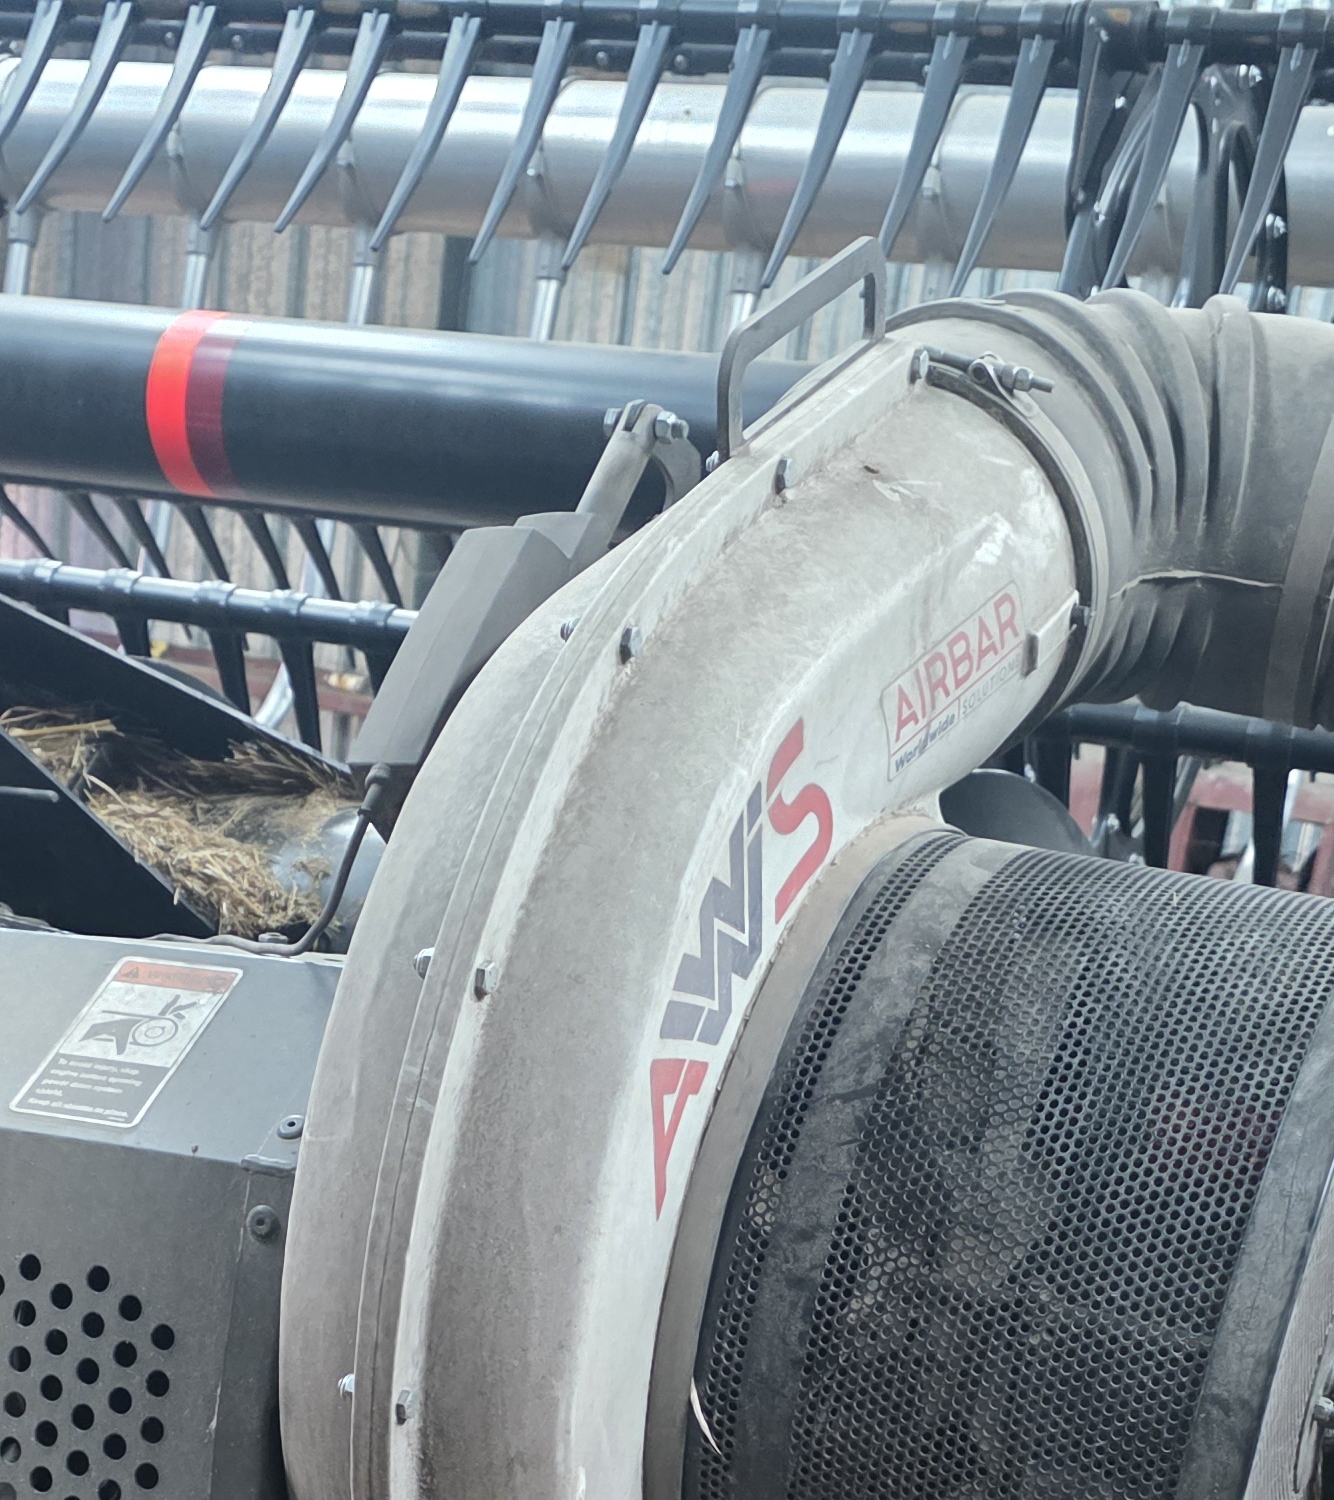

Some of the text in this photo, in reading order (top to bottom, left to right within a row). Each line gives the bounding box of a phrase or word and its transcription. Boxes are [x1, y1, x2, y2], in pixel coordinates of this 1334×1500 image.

[895, 593, 1019, 743] AIRBAR
[895, 658, 1021, 772] Worldwide SOLUTION
[649, 717, 835, 1222] AWS
